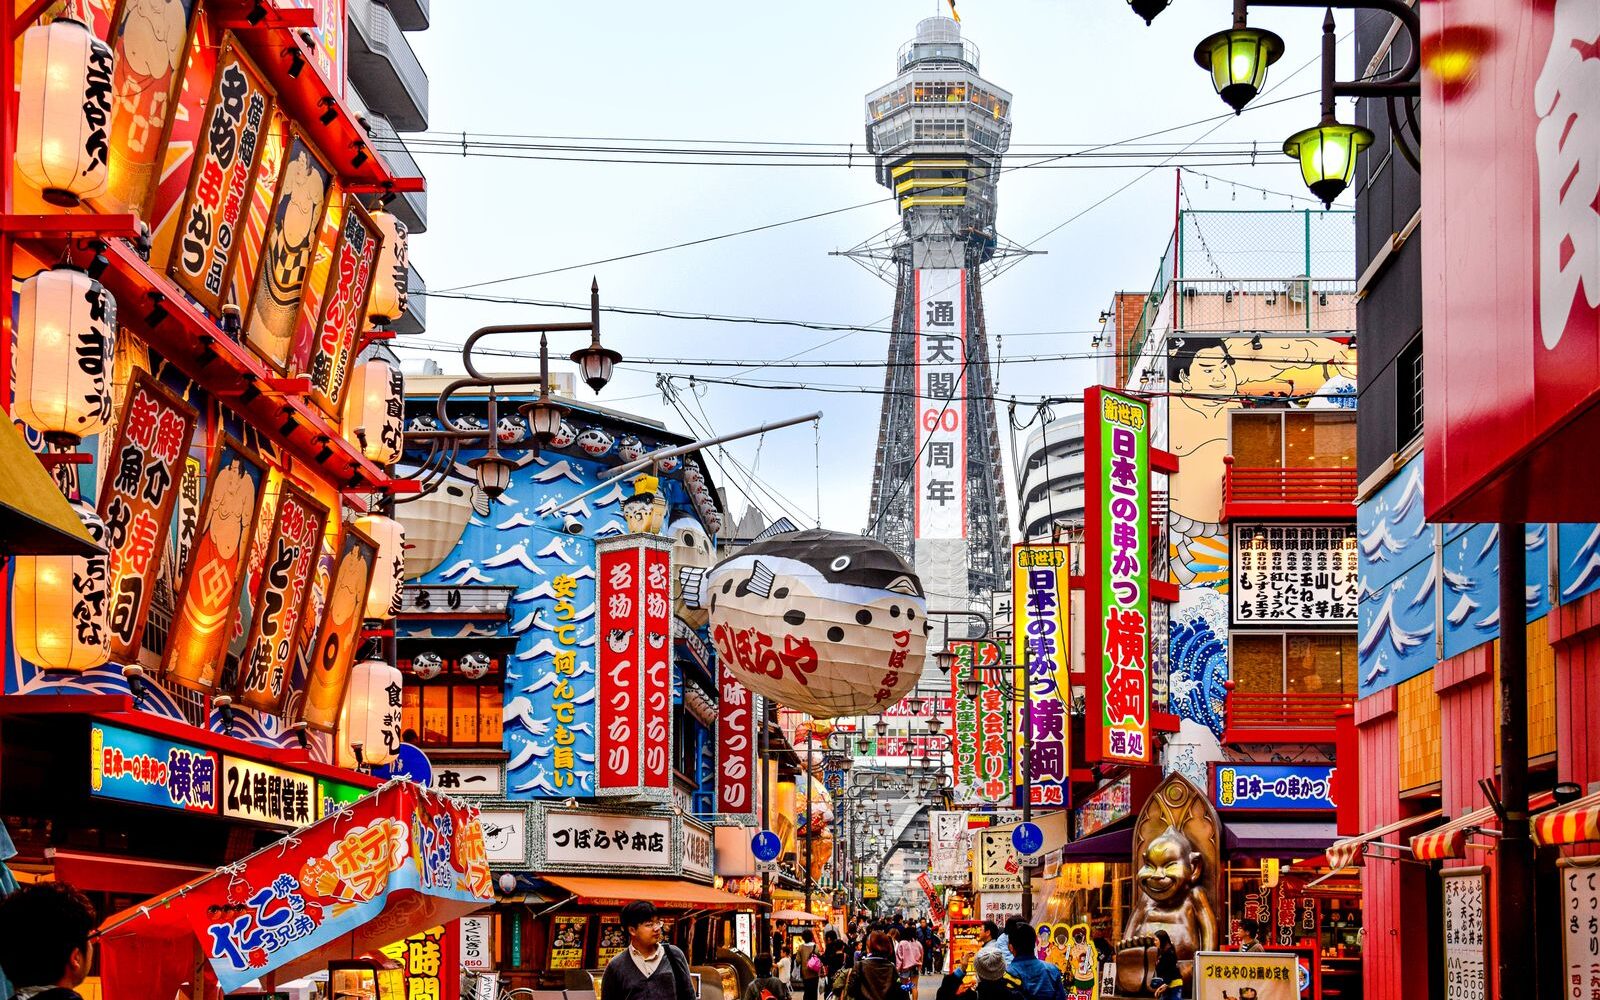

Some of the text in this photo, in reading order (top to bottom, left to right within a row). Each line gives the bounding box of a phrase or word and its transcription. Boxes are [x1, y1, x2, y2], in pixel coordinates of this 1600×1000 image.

[181, 61, 249, 275] 名物串かつ
[126, 389, 185, 466] 新鮮
[923, 301, 959, 507] 通天閣60周年
[1104, 397, 1144, 430] 新世界
[280, 499, 303, 543] 名物
[1112, 428, 1139, 607] 日本一の串かつ
[1019, 550, 1064, 567] 新世界
[270, 515, 318, 698] 大阪下町の味
[608, 562, 632, 620] 名物
[647, 562, 667, 620] 名物
[1240, 572, 1253, 618] もち
[1255, 572, 1268, 618] うずら玉子
[1270, 572, 1284, 618] 紅しょうが
[1285, 572, 1299, 618] にんにく
[1300, 572, 1313, 618] 玉ねぎ
[1315, 572, 1328, 618] 山芋
[1330, 572, 1343, 618] しし唐
[1345, 572, 1358, 618] れんこん
[713, 622, 818, 685] づぼらや
[1027, 570, 1057, 696] 日本一の串かつ
[875, 629, 911, 703] づぼらや
[1105, 608, 1146, 727] 横綱
[607, 659, 631, 776] てっちり
[647, 660, 666, 776] てっちり
[1019, 699, 1063, 782] 横綱
[1110, 730, 1144, 757] 酒処
[103, 747, 167, 786] 日本一の串かつ
[168, 749, 214, 808] 横綱
[227, 766, 309, 823] 24時間営業
[431, 769, 487, 788] 本一
[1222, 770, 1233, 804] 新世界
[1236, 777, 1325, 797] 日本一の串かつ
[552, 827, 665, 853] づぼらや本店
[210, 874, 307, 970] たこ焼き
[1569, 873, 1579, 933] てっさ
[1587, 873, 1599, 955] てっちり
[262, 914, 316, 953] 3兄弟
